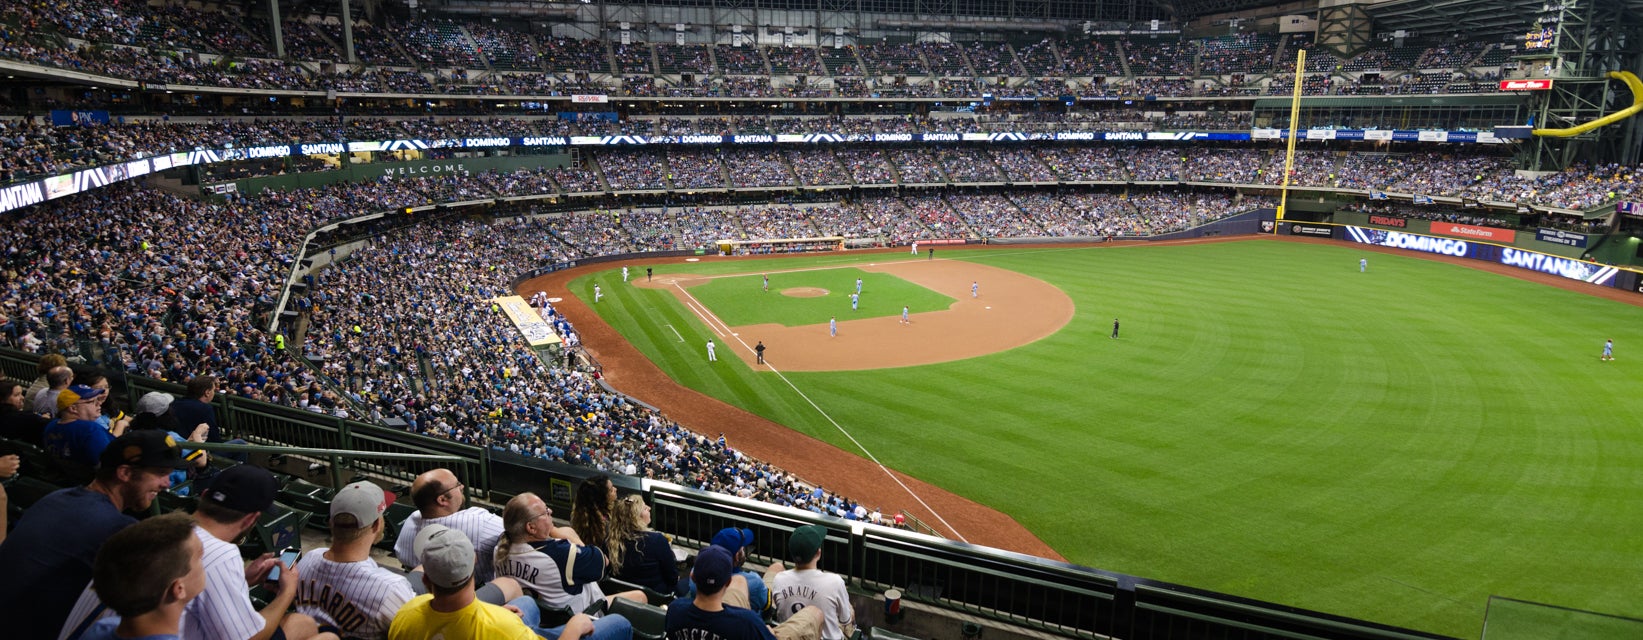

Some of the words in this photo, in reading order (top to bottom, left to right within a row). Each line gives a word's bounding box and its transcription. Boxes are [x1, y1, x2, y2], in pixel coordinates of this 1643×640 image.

[78, 112, 93, 122] PNC
[466, 137, 510, 147] DOMINGO
[523, 137, 566, 146] SANTANA
[734, 135, 772, 143] SANTANA
[923, 133, 959, 141] SANTANA
[249, 145, 290, 158] DOMINGO
[301, 143, 344, 155] SANTANA
[385, 164, 464, 176] WELCOME
[0, 182, 44, 214] ANTANA
[1370, 215, 1404, 227] FRIDAYS
[1386, 232, 1467, 256] DOMINGO
[782, 586, 818, 600] BRAUN
[296, 579, 367, 632] LLARDO
